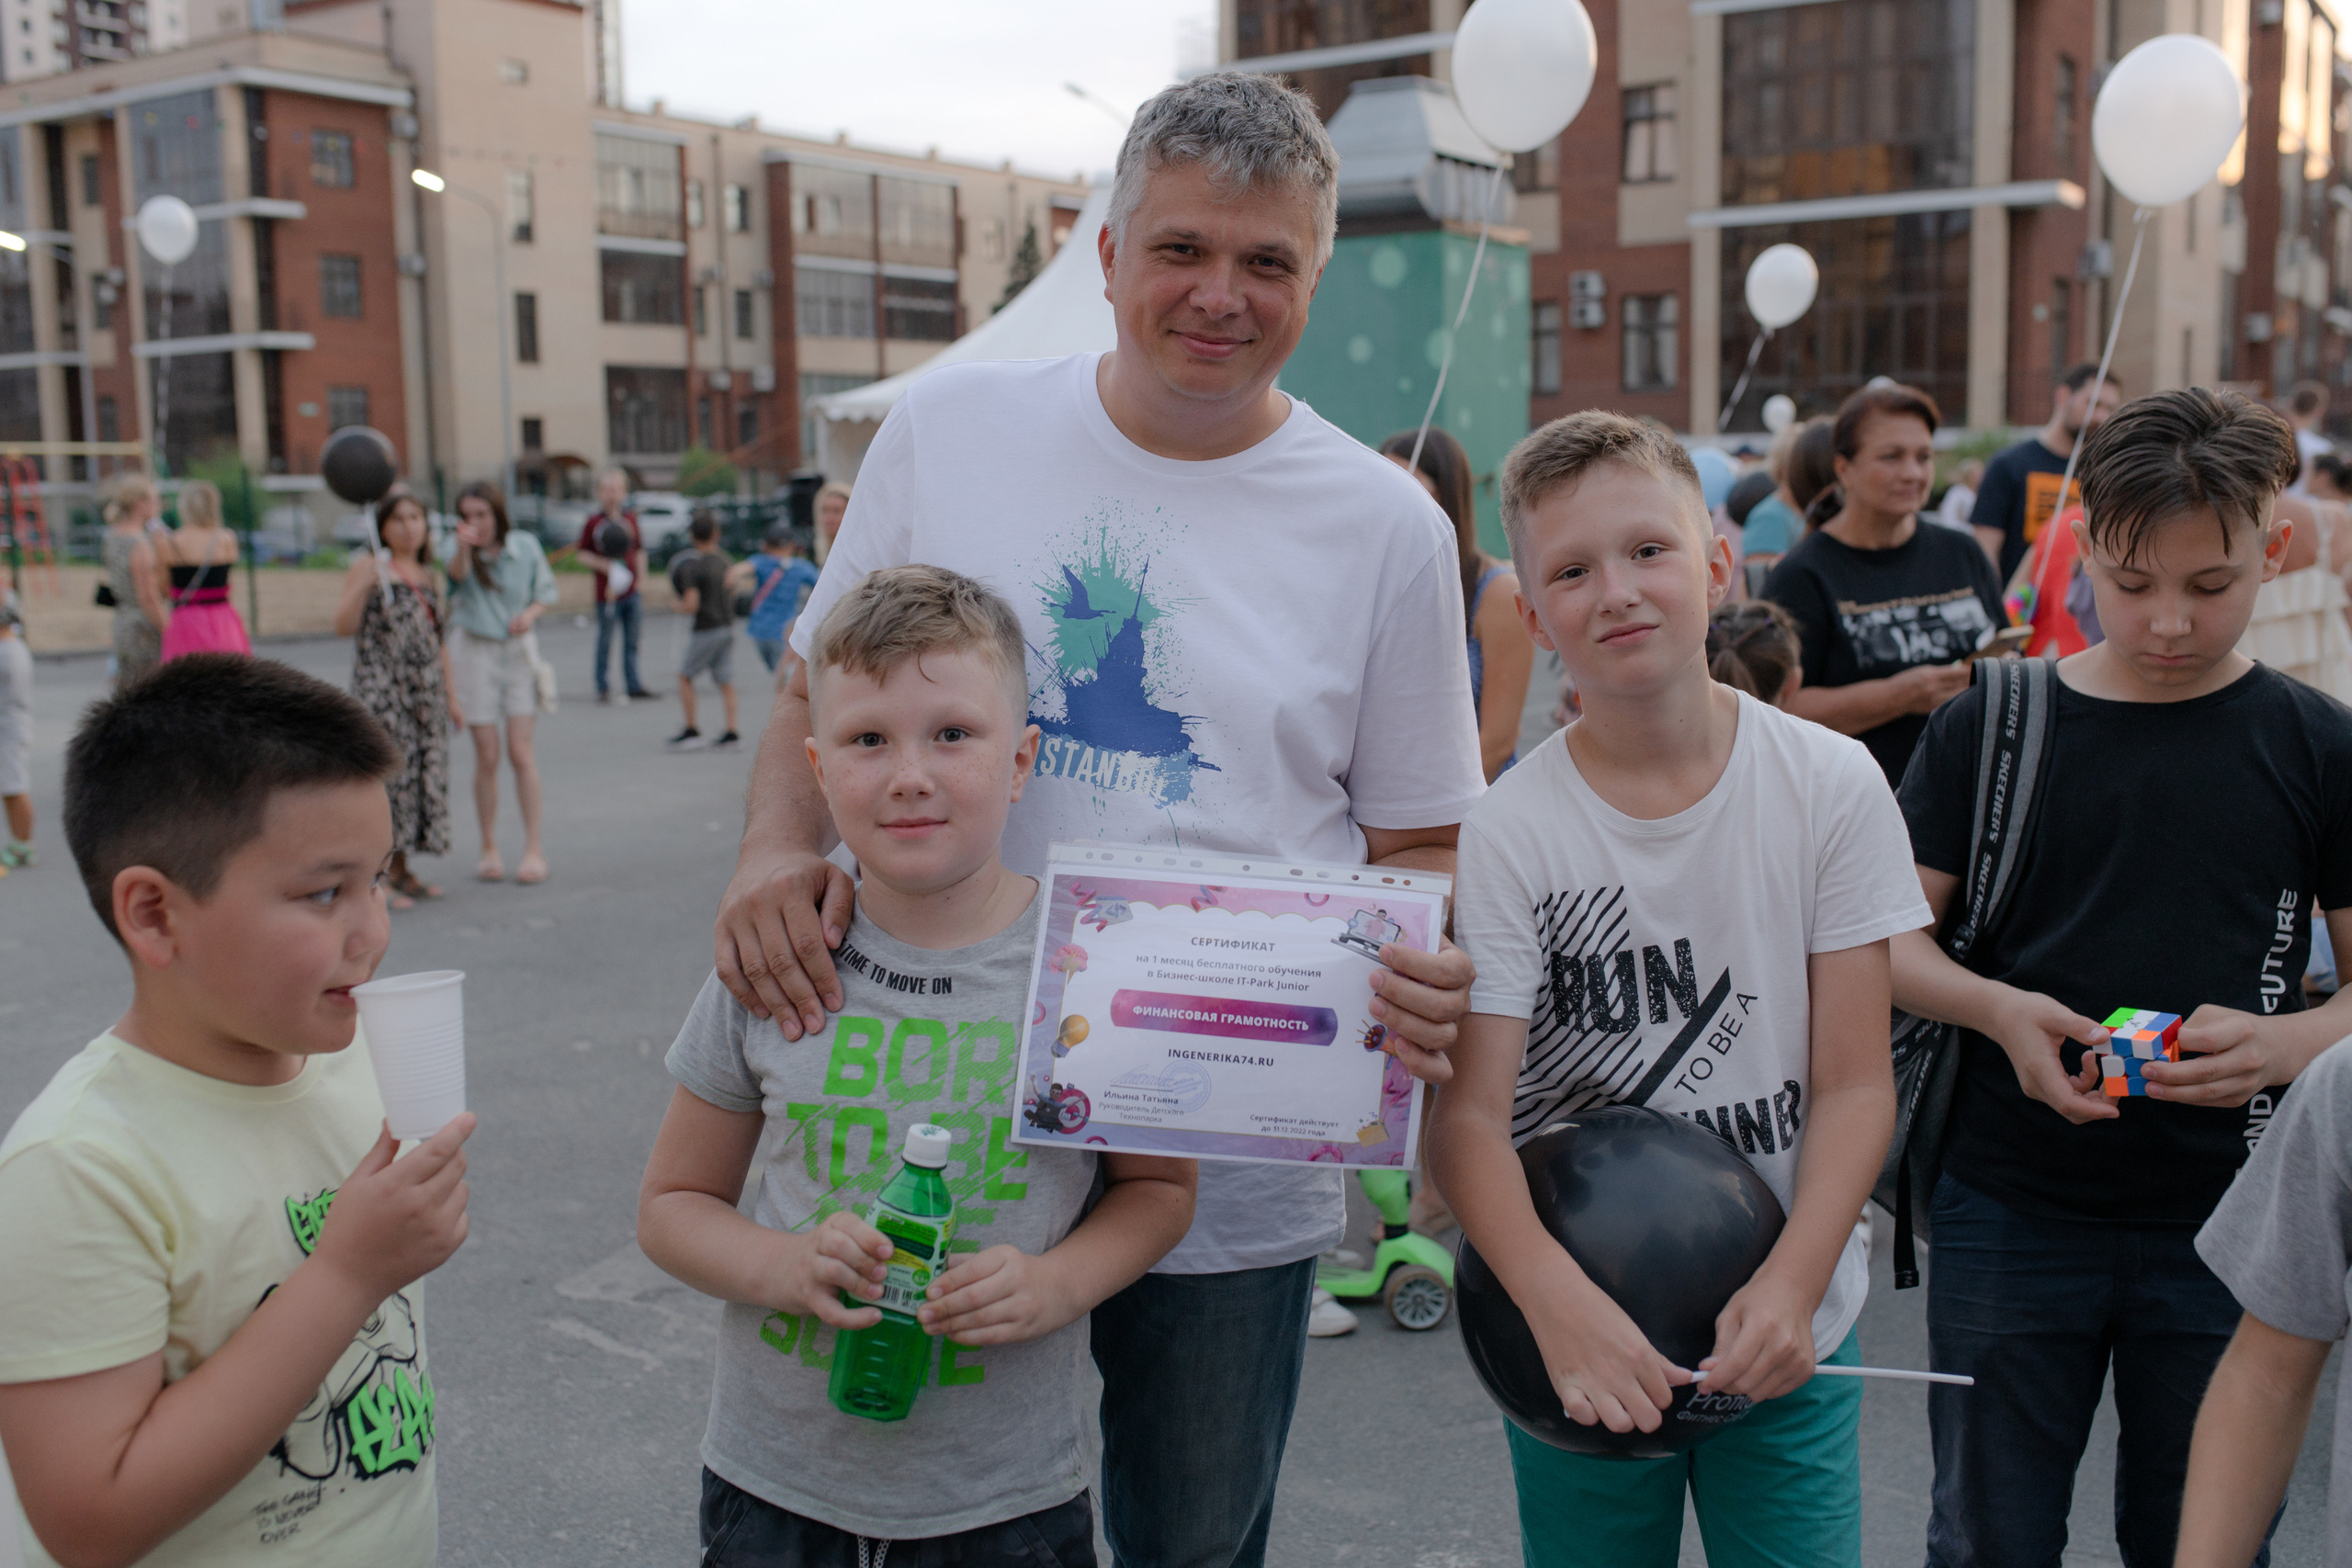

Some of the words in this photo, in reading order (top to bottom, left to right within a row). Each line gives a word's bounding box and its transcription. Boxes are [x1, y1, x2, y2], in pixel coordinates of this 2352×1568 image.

[2006, 663, 2020, 740] SKECHERS
[1989, 749, 2012, 843] SKECHERS
[1970, 852, 1992, 930] SKECHER
[1191, 937, 1275, 953] СЕРТИФИКАТ
[2260, 888, 2298, 1013] FUTURE
[840, 943, 870, 974] TIME
[870, 964, 887, 984] TO
[886, 971, 927, 994] MOVE
[932, 976, 952, 994] ON
[1157, 970, 1234, 985] Бизнес-школе
[1237, 976, 1274, 988] IT-Park
[1276, 980, 1310, 992] Junior
[1160, 957, 1193, 967] месяц
[1196, 958, 1264, 973] бесплатного
[1268, 966, 1321, 977] обучения
[1551, 937, 1699, 1034] RUN
[1132, 1005, 1217, 1022] ФИНАНСОВАЯ
[1220, 1013, 1309, 1031] ГРАМОТНОСТЬ
[823, 1016, 1018, 1103] BOR
[1168, 1049, 1274, 1066] INGENERIKA74.RU
[1674, 1057, 1713, 1094] TO
[1707, 1012, 1743, 1055] BE
[1736, 993, 1758, 1015] A
[1099, 1101, 1149, 1113] Руководитель
[1150, 1106, 1184, 1116] Детского
[1103, 1090, 1139, 1101] Ильина
[1142, 1094, 1179, 1104] Татьяна
[1119, 1112, 1162, 1123] Технопарка
[1250, 1114, 1296, 1124] Сертификат
[1299, 1119, 1340, 1129] действует
[786, 1102, 891, 1193] TO
